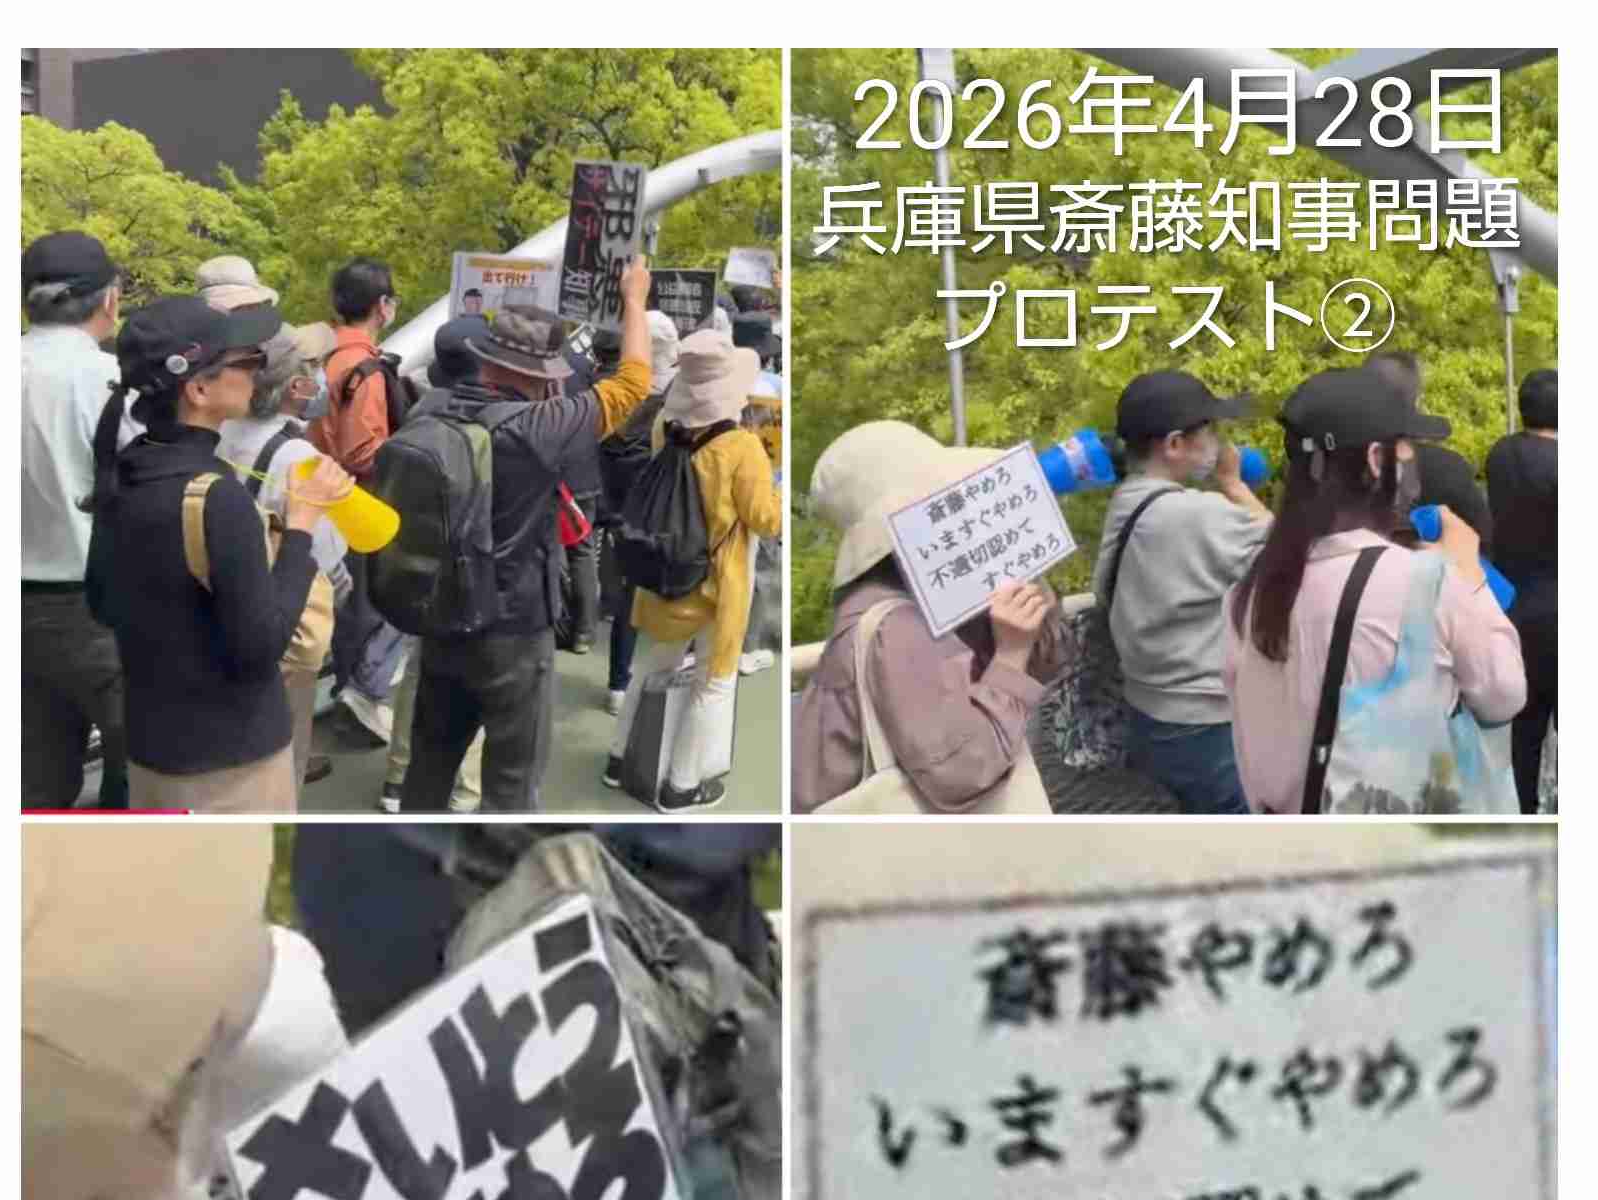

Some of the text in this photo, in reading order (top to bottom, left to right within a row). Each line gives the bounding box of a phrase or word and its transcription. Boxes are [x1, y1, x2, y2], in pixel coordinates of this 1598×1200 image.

[917, 485, 1038, 559] いますぐやめろ
[928, 517, 1034, 589] 不適切認めて
[982, 533, 1061, 591] すぐやめろ
[868, 1026, 1499, 1169] いますぐやめろ
